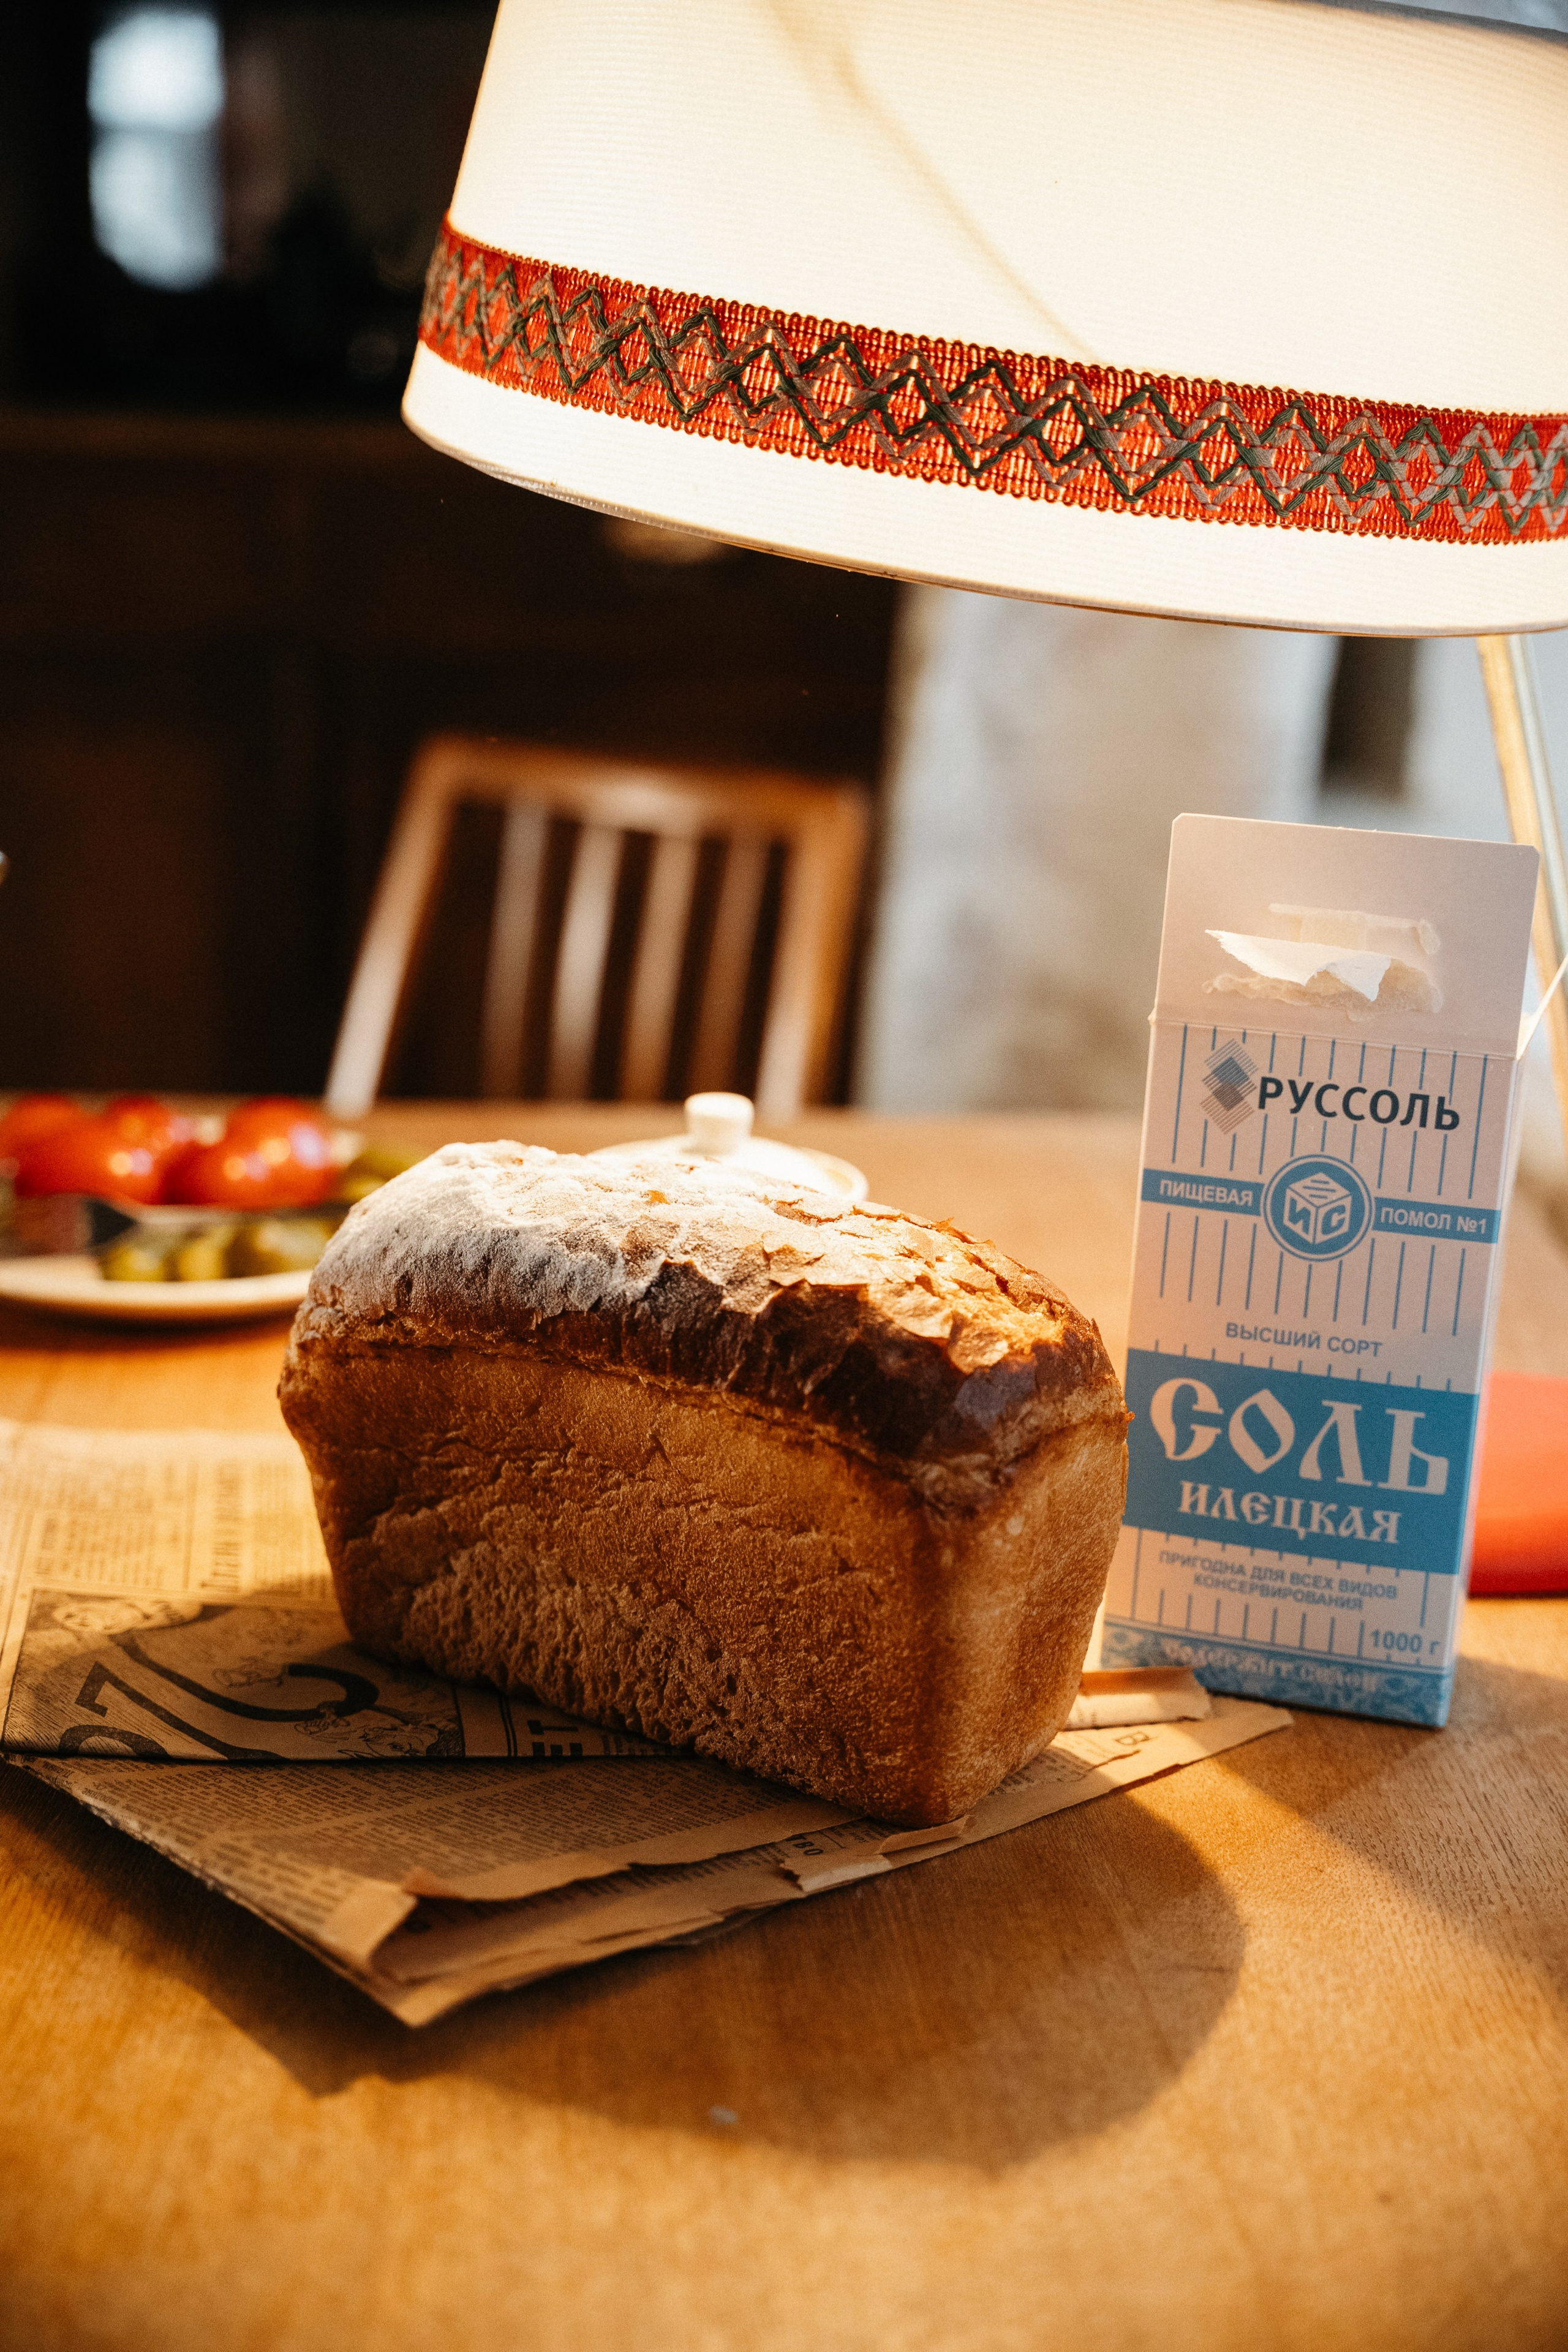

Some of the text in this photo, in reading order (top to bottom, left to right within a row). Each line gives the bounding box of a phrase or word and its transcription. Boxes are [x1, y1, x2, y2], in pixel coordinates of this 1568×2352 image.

[1258, 1076, 1460, 1131] РУССОЛЬ
[1160, 1179, 1253, 1207] ПИЩЕВАЯ
[1381, 1207, 1487, 1234] ПОМОЛ №1
[1226, 1322, 1383, 1357] ВЫСШИЙ СОРТ
[1150, 1378, 1449, 1495] СОЛЬ
[1178, 1480, 1403, 1544] ИЛЕЦКАЯ
[1159, 1550, 1398, 1600] ПРИГОДНА ДЛЯ ВСЕХ ВИДОВ
[1193, 1572, 1365, 1611] КОНСЕРВИРОВАНИЯ
[1372, 1629, 1441, 1656] 1000 г
